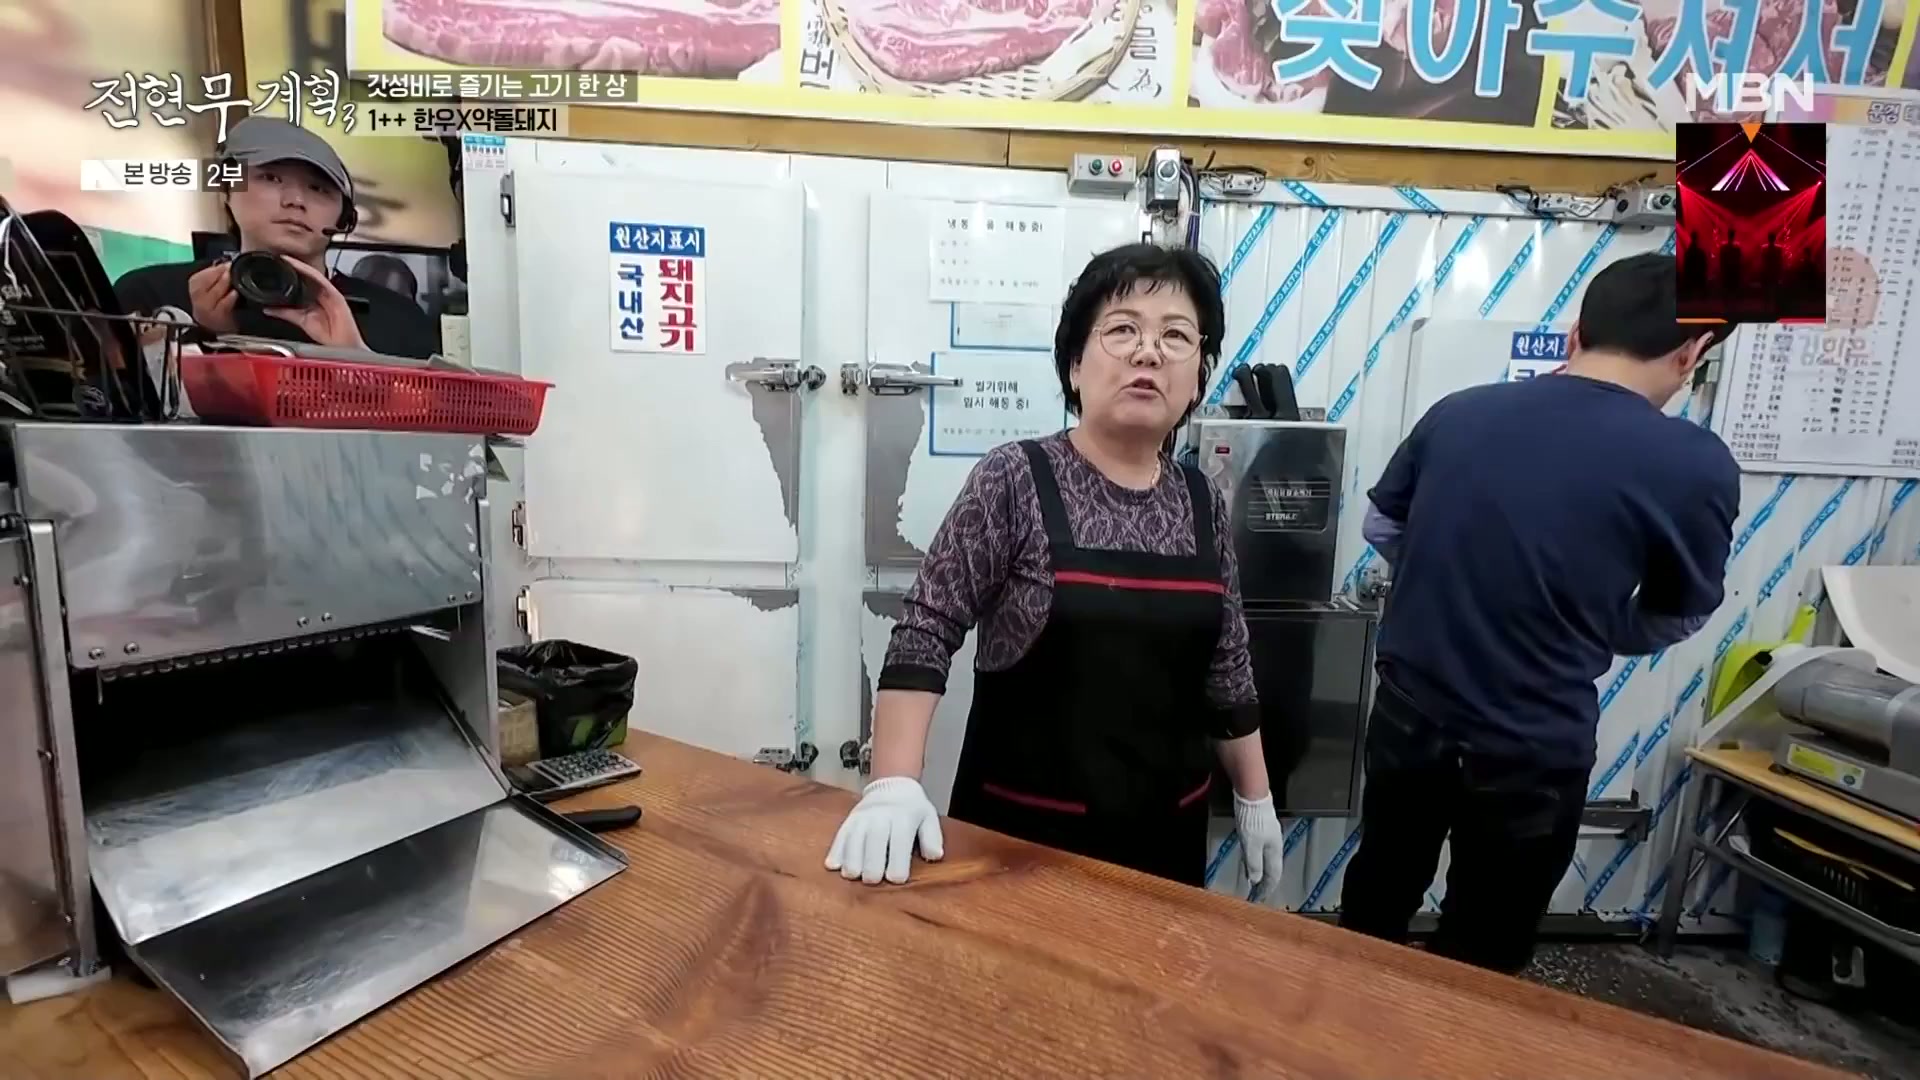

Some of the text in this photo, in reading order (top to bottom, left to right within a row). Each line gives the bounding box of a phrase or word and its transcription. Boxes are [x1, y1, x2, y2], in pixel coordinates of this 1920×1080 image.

[614, 225, 701, 254] 원산지표시
[617, 263, 645, 341] 국내산
[658, 259, 697, 353] 돼지고기
[1516, 335, 1569, 358] 원산지
